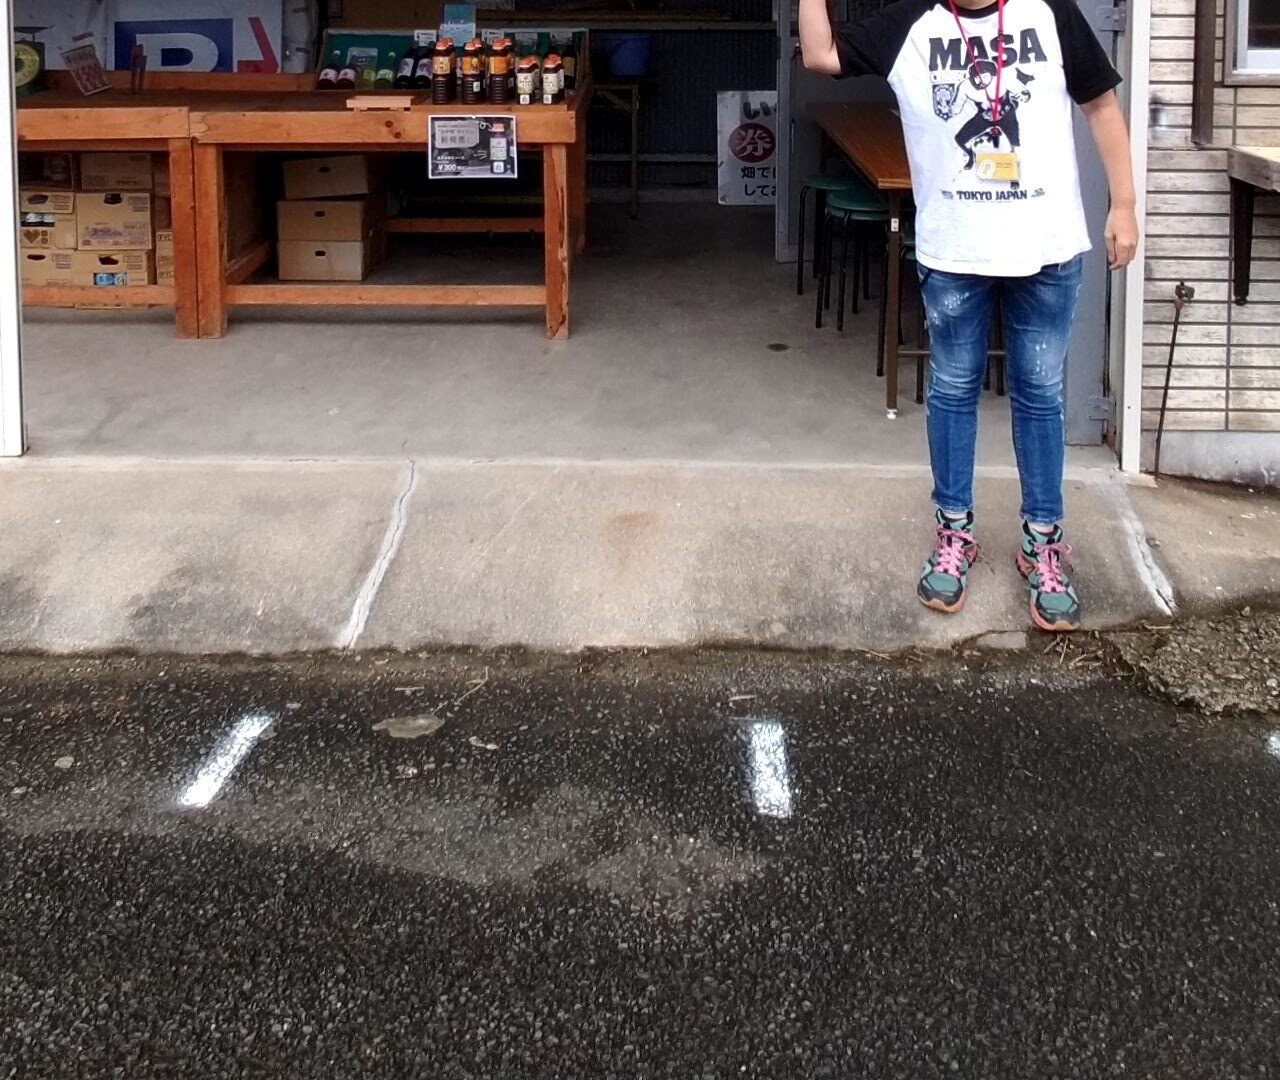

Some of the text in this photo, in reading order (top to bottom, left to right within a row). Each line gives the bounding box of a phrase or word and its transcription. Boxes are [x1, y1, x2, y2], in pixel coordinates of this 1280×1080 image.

[928, 27, 1048, 71] MASA
[956, 189, 993, 201] TOKYO
[994, 188, 1028, 200] JAPAN
